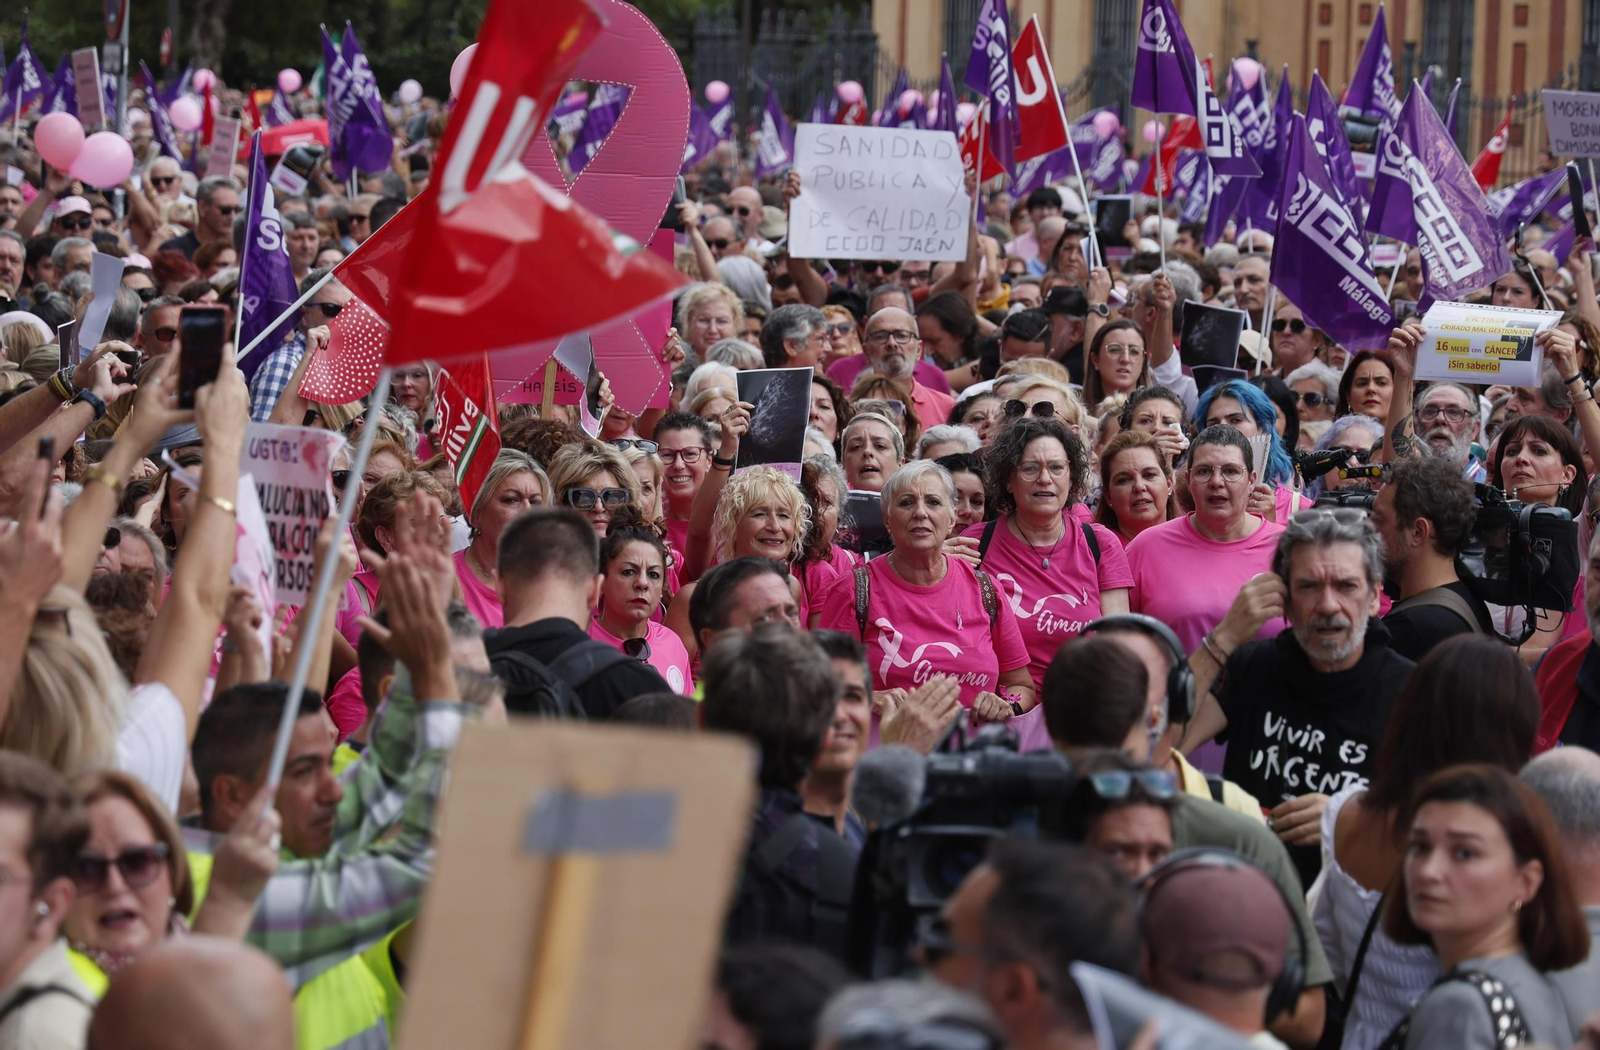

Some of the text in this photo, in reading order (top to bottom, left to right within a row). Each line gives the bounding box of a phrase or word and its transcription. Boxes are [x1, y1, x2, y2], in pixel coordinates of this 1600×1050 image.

[813, 133, 953, 160] SANIDAD
[811, 164, 963, 209] PUBLICA Y
[808, 205, 963, 233] DE CALIDAD
[825, 229, 956, 254] CCOO JAÉN
[1338, 274, 1391, 326] Málaga
[1440, 324, 1471, 332] CRIBADO
[1472, 325, 1487, 333] MAL
[1488, 326, 1534, 336] GESTIONADO
[1435, 340, 1449, 351] 16
[1450, 345, 1470, 353] MESES
[1484, 344, 1517, 356] CÁNCER
[1448, 360, 1501, 372] ¡Sin saberlo!
[1338, 740, 1369, 764] ES
